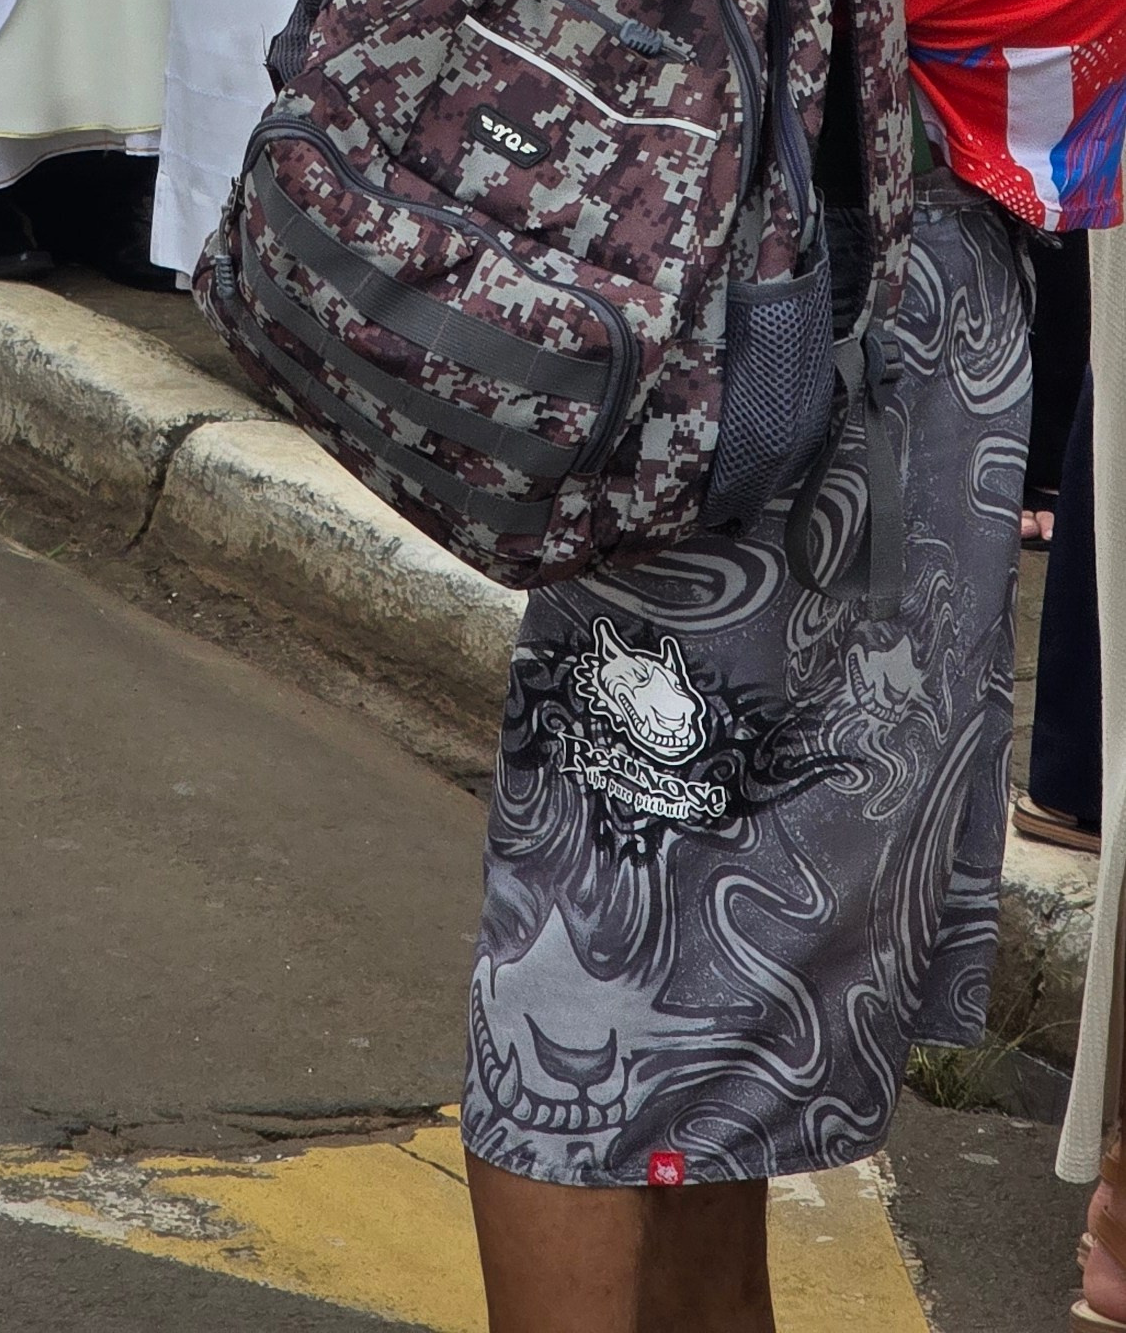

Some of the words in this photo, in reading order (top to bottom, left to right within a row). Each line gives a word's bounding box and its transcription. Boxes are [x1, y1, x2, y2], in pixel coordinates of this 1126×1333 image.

[585, 767, 607, 790] the
[607, 778, 633, 804] pure
[634, 792, 690, 820] pitbull
